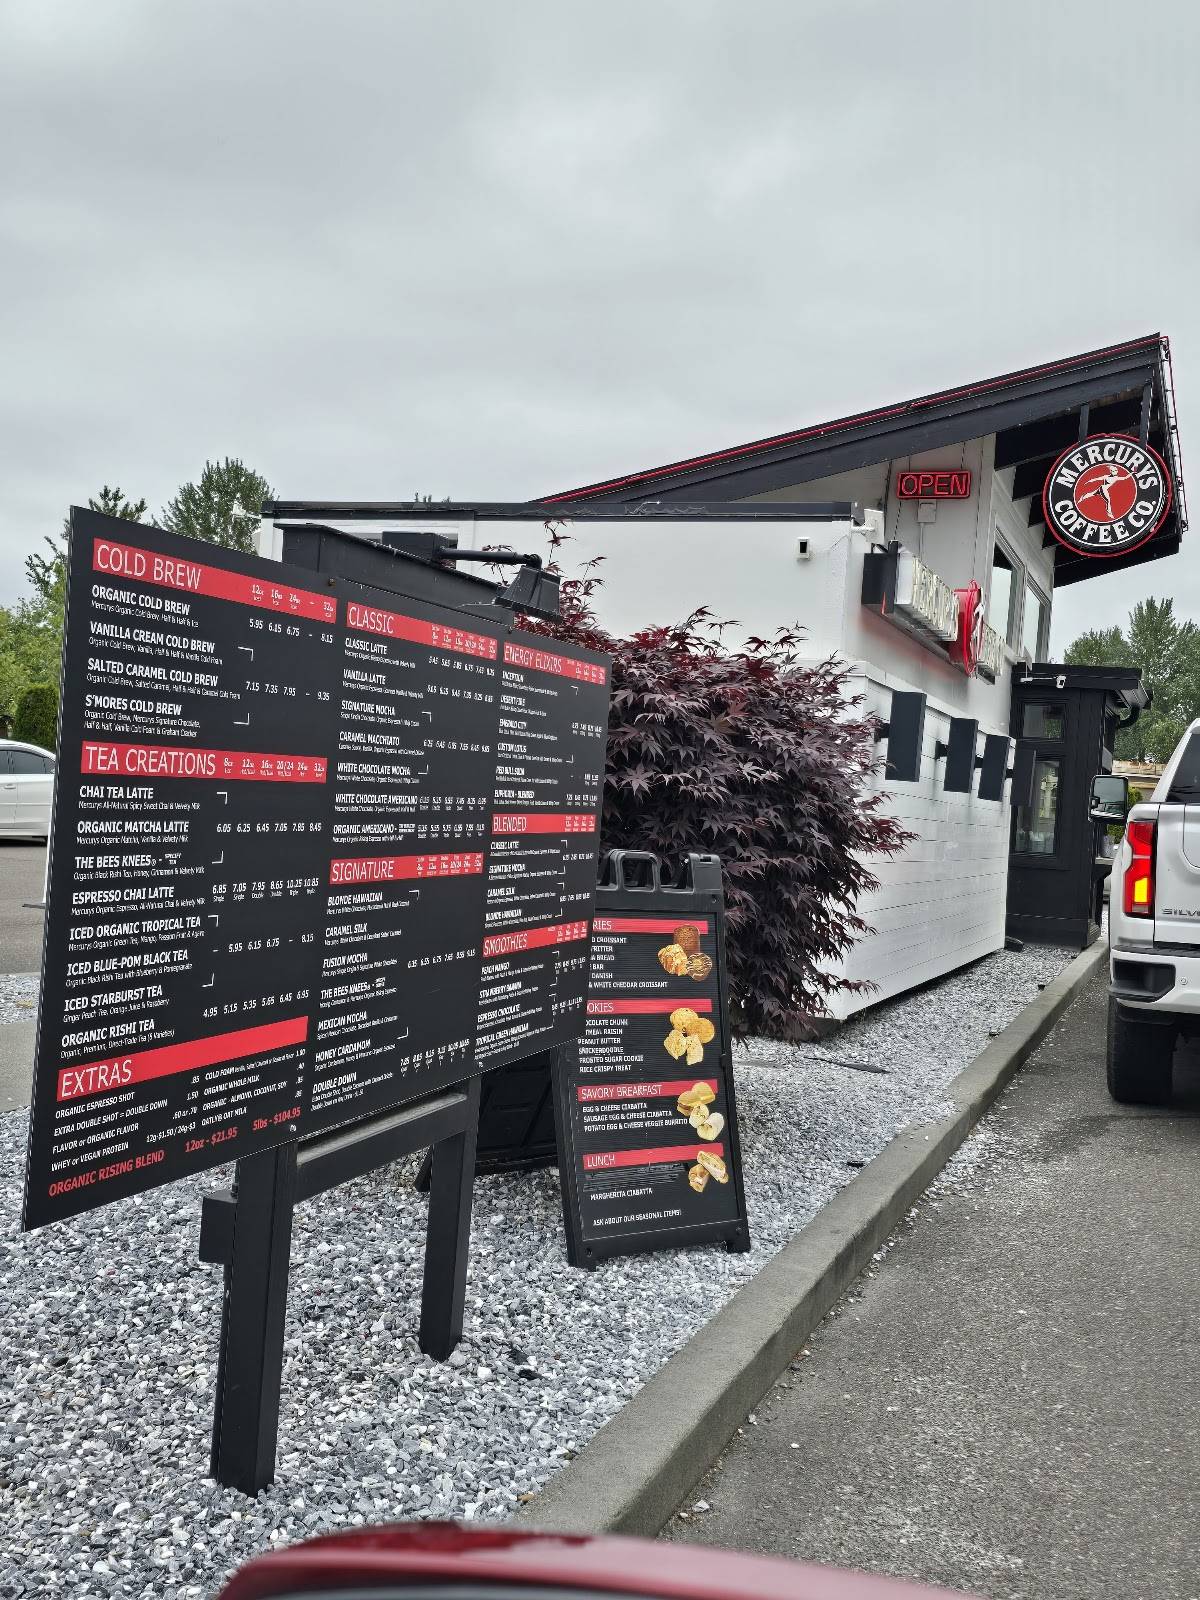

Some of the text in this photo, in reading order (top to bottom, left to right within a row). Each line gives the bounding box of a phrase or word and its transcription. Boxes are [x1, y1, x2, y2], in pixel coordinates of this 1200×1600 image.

[1056, 444, 1158, 489] MERCURYS
[901, 474, 966, 495] OPEN
[1055, 500, 1156, 542] COFFEE CO.
[98, 544, 202, 590] COLD BREW
[92, 584, 190, 615] ORGANIC COLD BREW
[349, 607, 394, 634] CLASSIC
[90, 621, 215, 653] VANILLA CREAM COLD BREW
[250, 619, 333, 644] 5.95 6.15 6.75 8.15
[345, 638, 387, 655] CLASSIC LATTE
[505, 646, 561, 673] ENERGY ELIXIRS
[88, 658, 218, 686] SALTED CARAMEL COLD BREW
[343, 669, 386, 685] VANILLA LATTE
[246, 681, 329, 700] 7.15 7.35 7.95 9.35
[86, 695, 182, 715] S'MORES COLD BREW
[341, 700, 395, 716] SIGNATURE MOCHA
[340, 731, 400, 746] CARAMEL MACCHIATO
[86, 746, 216, 775] TEA CREATIONS
[338, 763, 411, 776] WHITE CHOCOLATE MOCHA
[80, 786, 153, 799] CHAI TEA LATTE
[336, 794, 417, 804] WHITE CHOCOLATE AMERICANO
[78, 821, 189, 833] ORGANIC MATCHA LATTE
[217, 823, 231, 832] 6.05
[237, 823, 251, 832] 6.25
[256, 823, 270, 832] 6.45
[334, 824, 394, 834] ORGANIC AMERICANO
[494, 817, 526, 831] BLENDED
[75, 856, 94, 868] THE
[97, 856, 120, 868] BEES
[332, 860, 394, 882] SIGNATURE
[73, 886, 174, 904] ESPRESSO CHAI LATTE
[328, 892, 383, 906] BLONDE HAWAIIAN
[70, 916, 200, 940] ICED ORGANIC TROPICAL TEA
[326, 923, 367, 937] CARAMEL SILK
[593, 921, 611, 930] RIES
[229, 934, 313, 953] 5.95 6.15 6.75 8.15
[484, 933, 527, 956] SMOOTHIES
[67, 949, 188, 976] ICED BLUE-POM BLACK TEA
[323, 956, 346, 968] FUSION
[347, 953, 368, 964] MOCHA
[64, 985, 162, 1012] ICED STARBURST TEA
[321, 988, 333, 1000] THE
[333, 986, 349, 997] BEES
[587, 1003, 613, 1012] OKIES
[318, 1011, 367, 1031] MEXICAN MOCHA
[61, 1019, 155, 1048] ORGANIC RISHI TEA
[316, 1048, 336, 1062] HONEY
[336, 1039, 370, 1057] CARDAMOM
[62, 1059, 132, 1097] EXTRAS
[313, 1072, 357, 1094] DOUBLE DOWN
[582, 1085, 662, 1100] SAVORY BREAKFAST
[56, 1092, 135, 1119] ORGANIC ESPRESSO SHOT
[54, 1099, 168, 1137] EXTRA DOUBLE SHOT DOUBLE DOWN
[53, 1123, 139, 1154] FLAVOR ORGANIC FLAVOR
[51, 1142, 129, 1171] WHEY VEGAN PROTEIN
[587, 1155, 615, 1167] LUNCH
[48, 1149, 165, 1197] ORGANIC RISING BLEND
